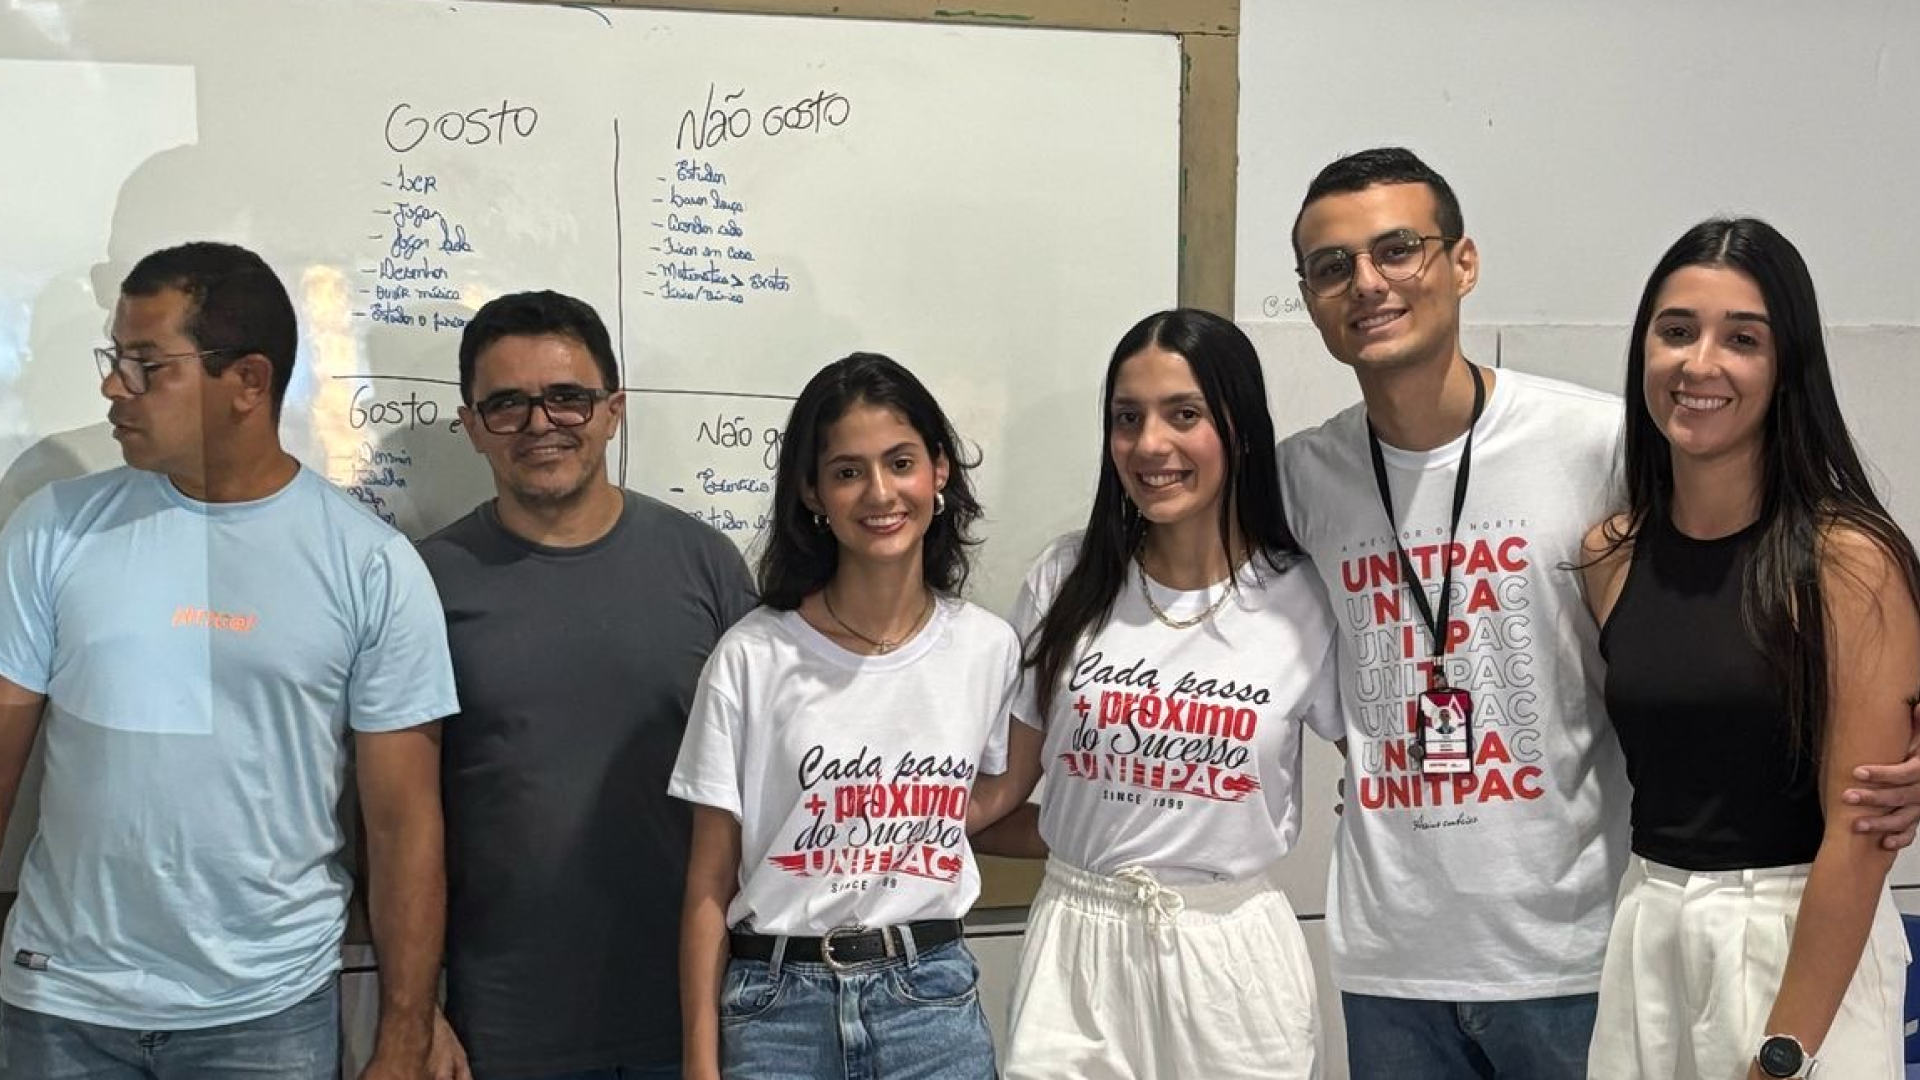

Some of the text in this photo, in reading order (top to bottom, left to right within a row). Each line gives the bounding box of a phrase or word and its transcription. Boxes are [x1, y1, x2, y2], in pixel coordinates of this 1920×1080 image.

[677, 82, 751, 149] Não
[697, 413, 752, 447] Não
[1069, 652, 1271, 704] Cada passo
[1073, 688, 1257, 741] + próximo
[1361, 691, 1538, 737] UNIAC
[1073, 709, 1249, 769] do Sucesso
[1363, 729, 1543, 774] UNAC
[799, 745, 883, 790] Cada
[1066, 753, 1252, 801] UNITPAC
[1360, 766, 1545, 809] UNITPAC
[804, 776, 968, 823] + próximo
[1104, 790, 1141, 804] SINCE
[794, 799, 962, 851] do Sucesso
